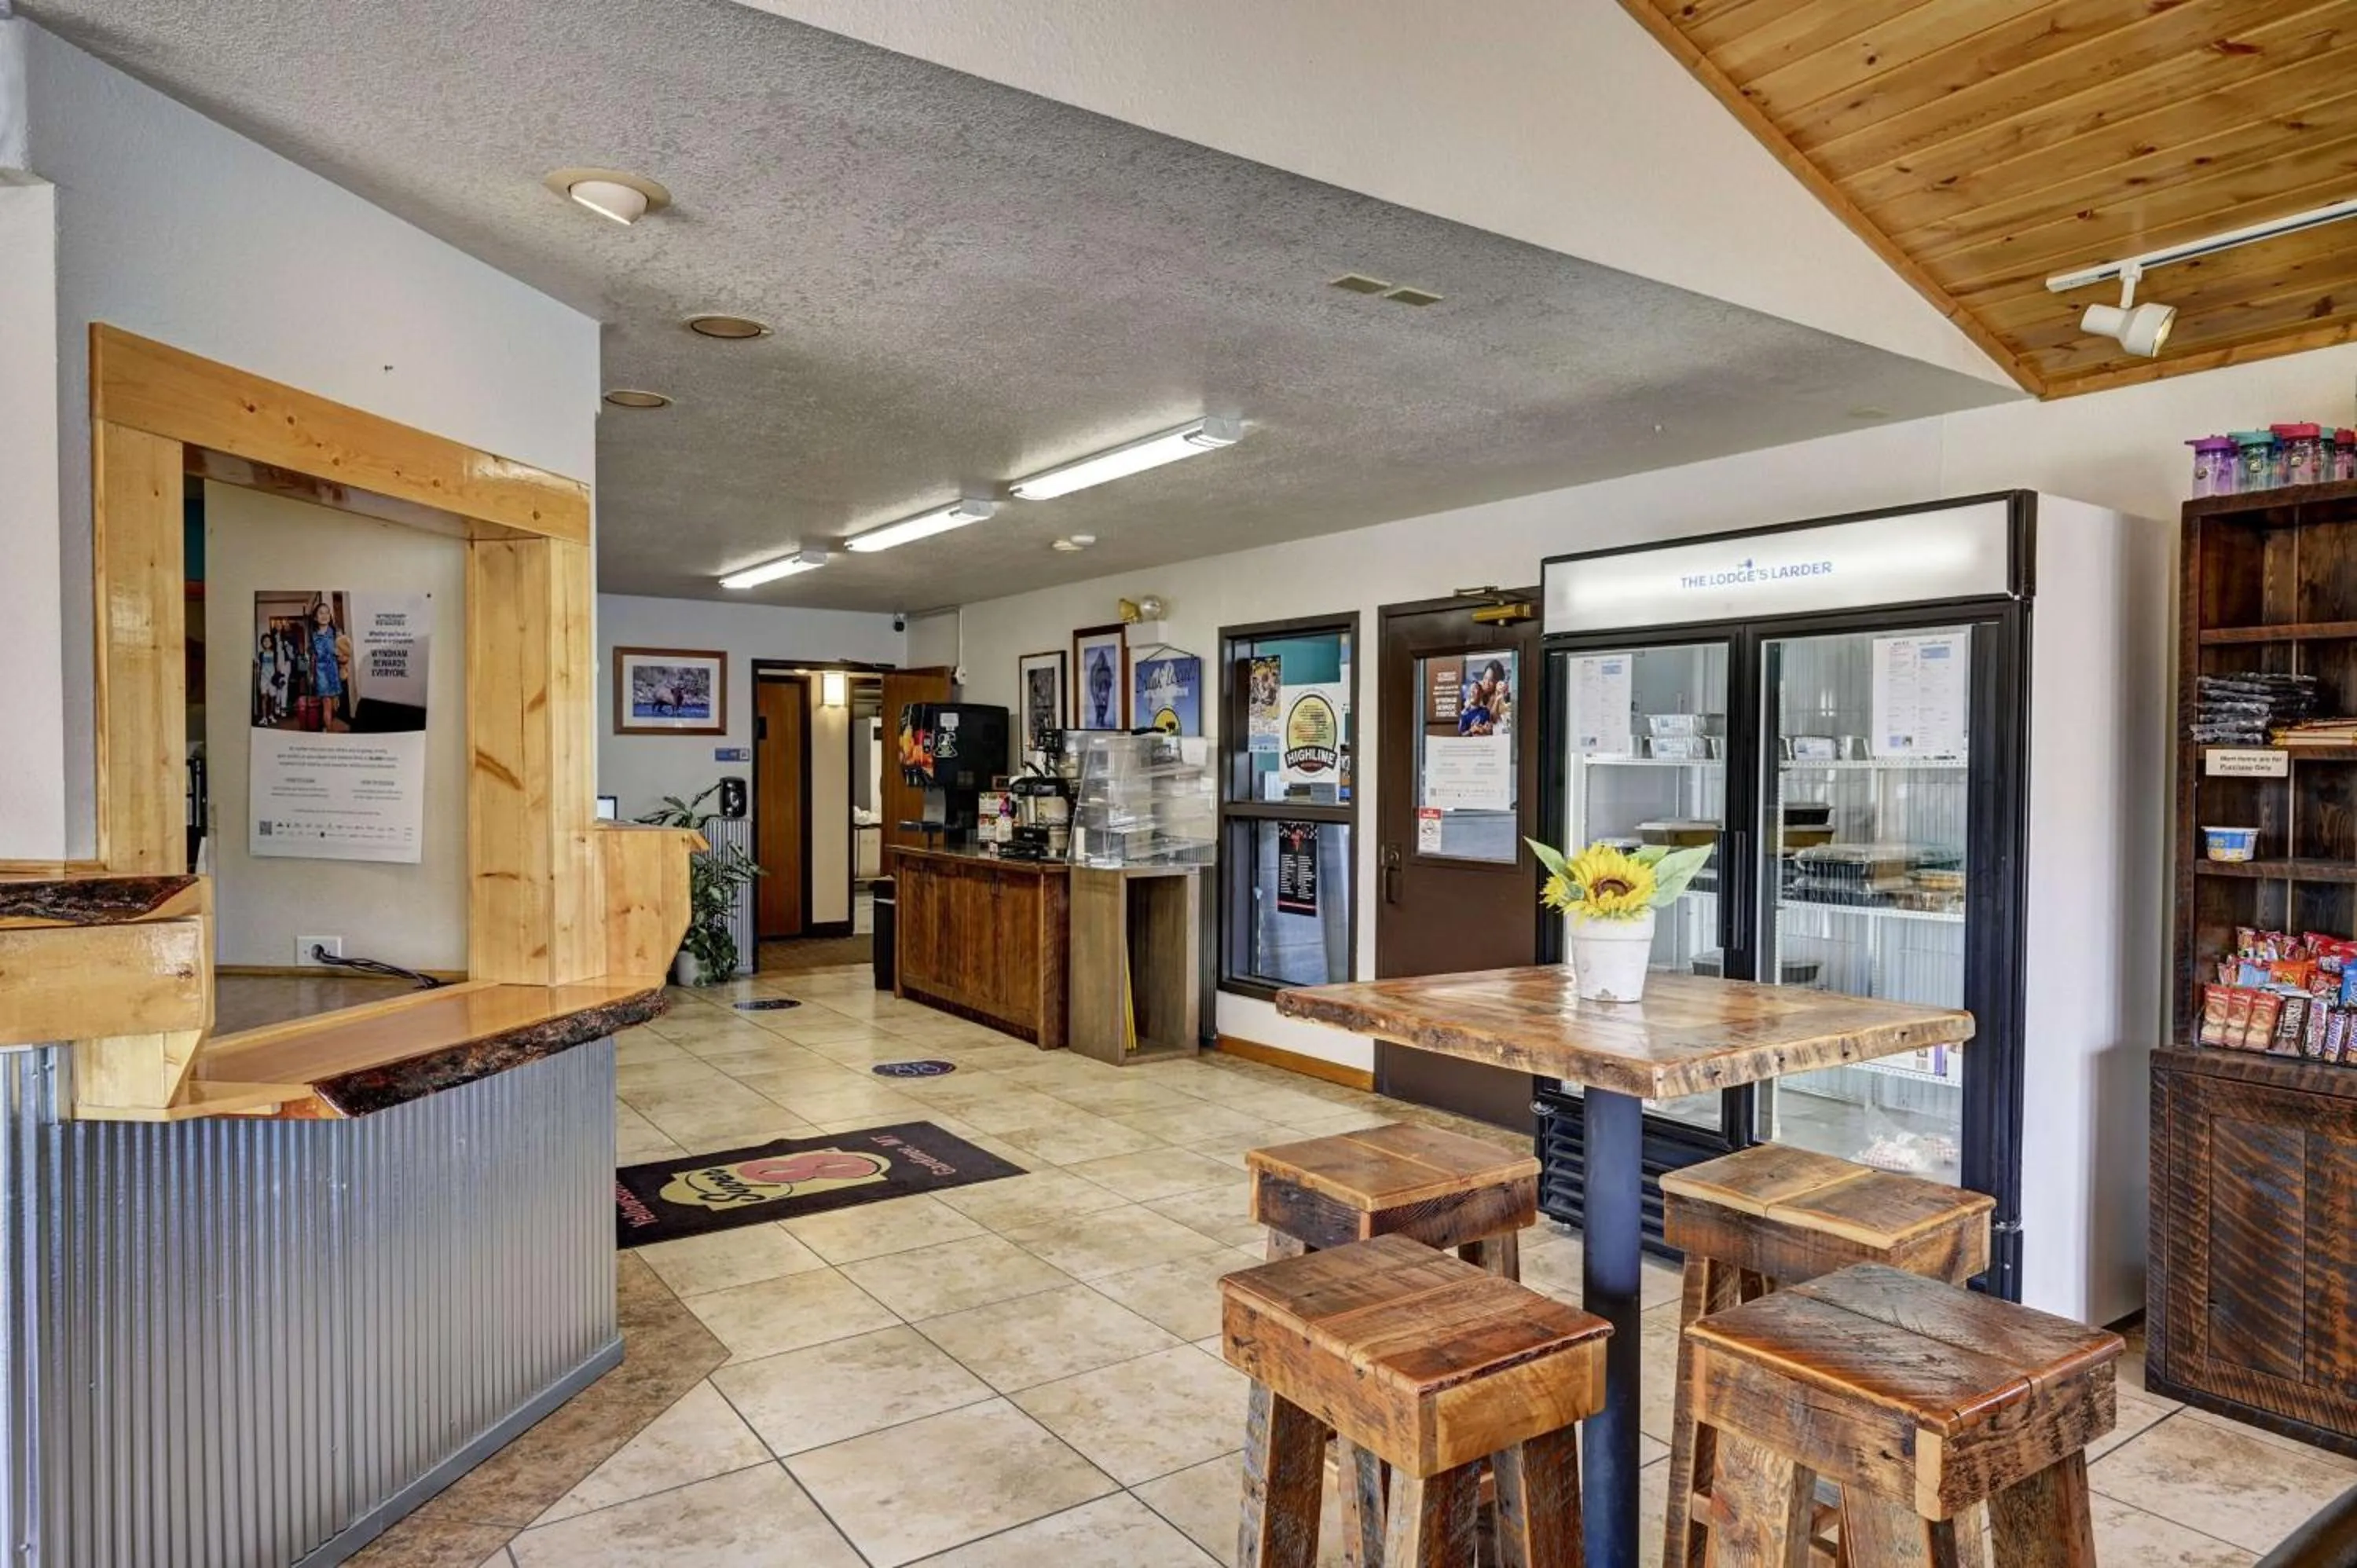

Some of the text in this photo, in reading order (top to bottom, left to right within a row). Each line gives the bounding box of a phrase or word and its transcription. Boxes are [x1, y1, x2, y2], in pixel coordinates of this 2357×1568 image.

[1681, 561, 1833, 588] THE LODGE'S LARDER
[371, 649, 408, 658] WYNDHAM
[373, 658, 406, 667] REWARDS
[1288, 747, 1335, 765] HIGHLINE
